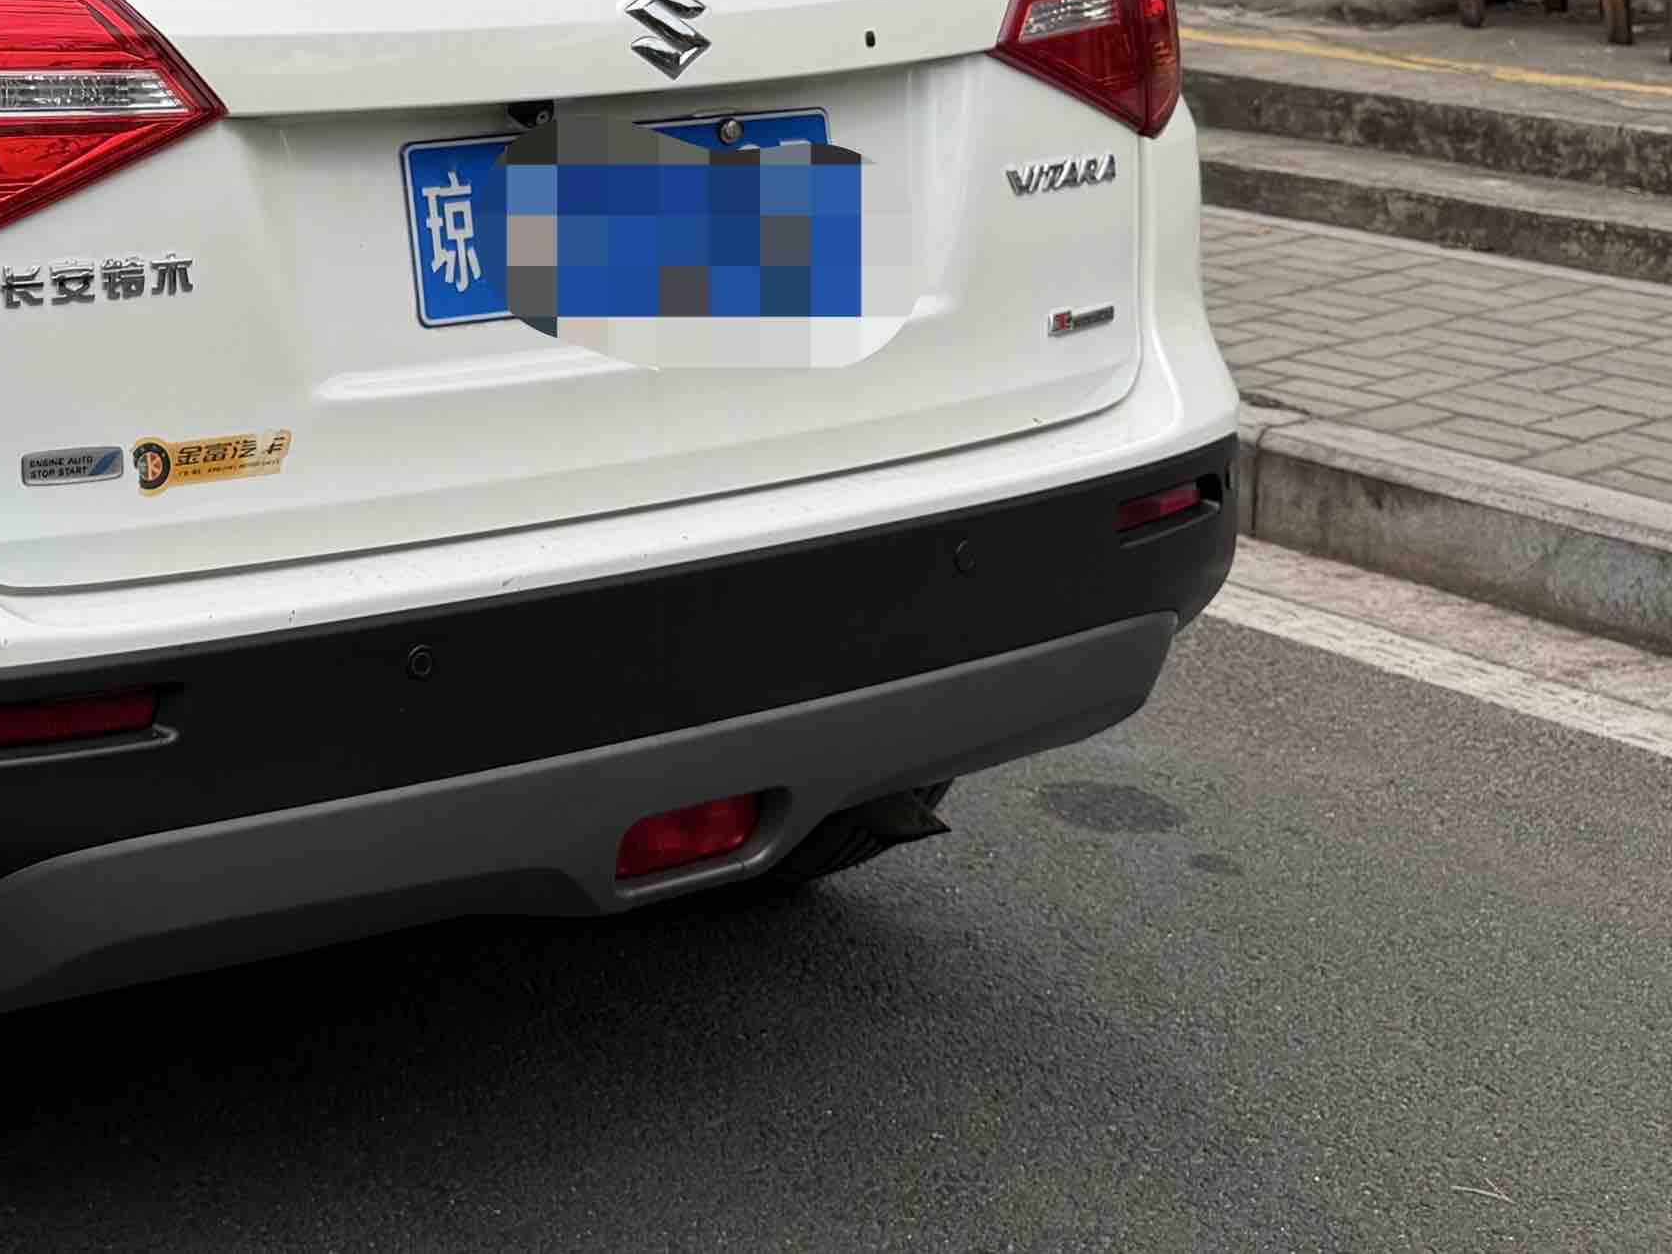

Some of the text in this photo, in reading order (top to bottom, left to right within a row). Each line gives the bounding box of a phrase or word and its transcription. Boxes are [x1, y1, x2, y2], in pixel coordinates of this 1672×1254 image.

[1006, 154, 1116, 196] VITARA
[0, 253, 194, 309] 长安铃木
[29, 455, 93, 468] ENGINE AUTO
[30, 465, 89, 479] STOP START
